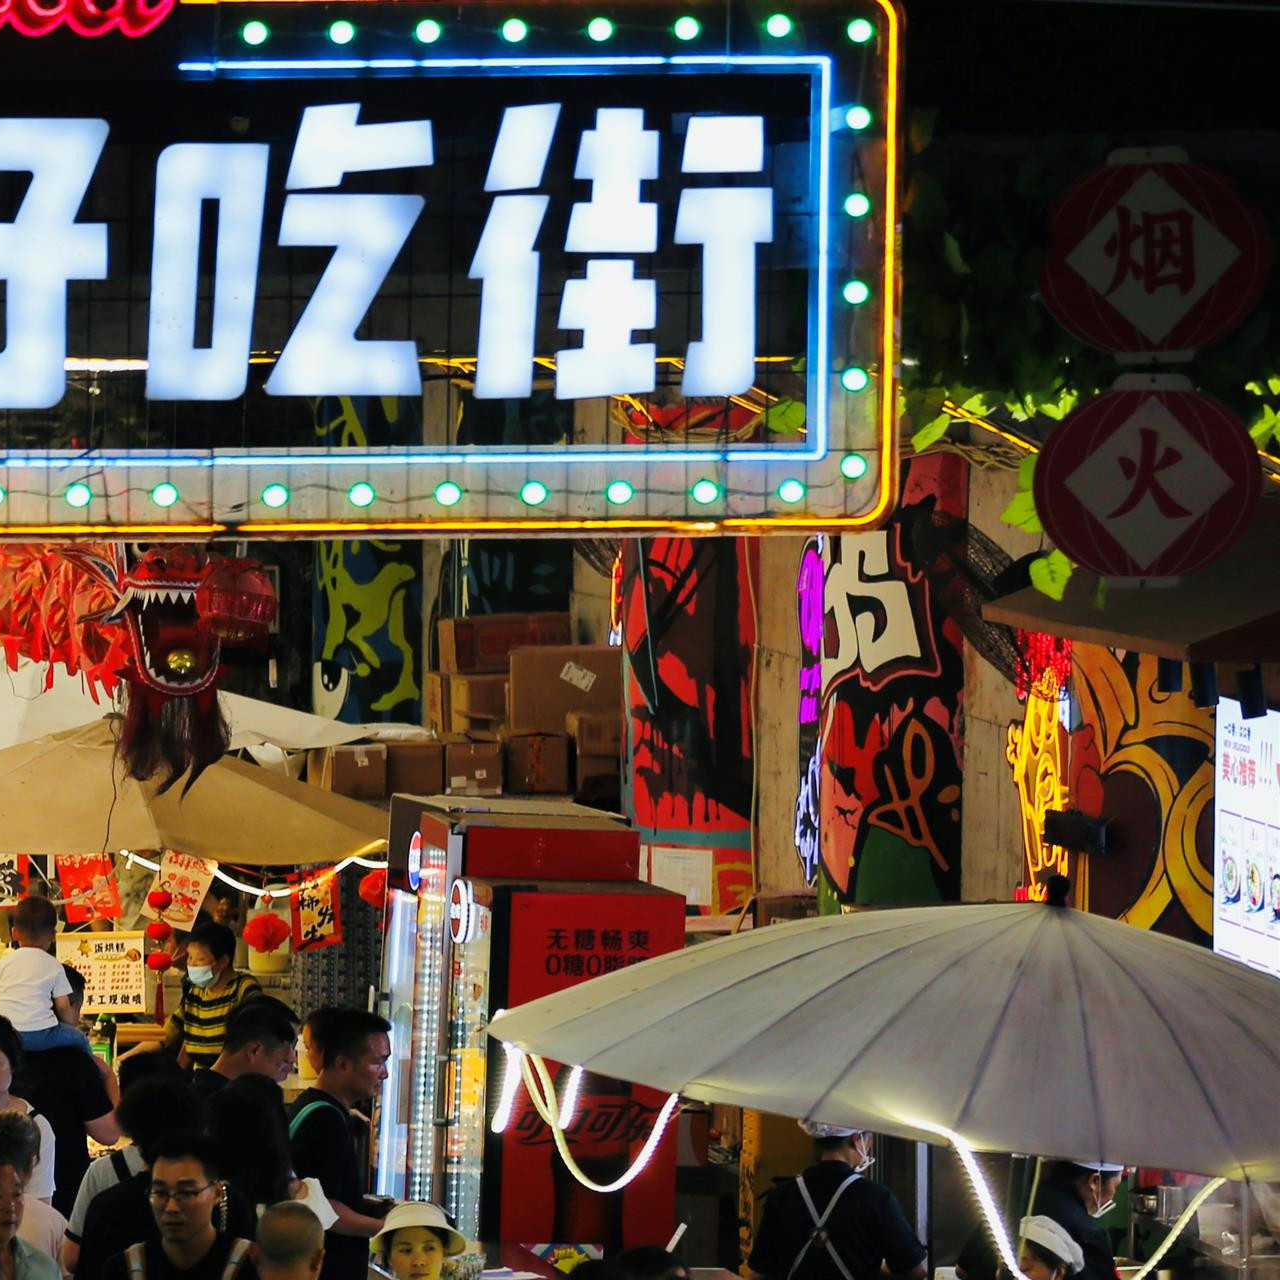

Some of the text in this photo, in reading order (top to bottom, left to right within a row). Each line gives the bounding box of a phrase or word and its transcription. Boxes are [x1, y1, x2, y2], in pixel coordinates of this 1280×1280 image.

[1104, 205, 1196, 298] 烟
[1105, 428, 1193, 519] 火
[547, 928, 649, 951] 无糖畅爽
